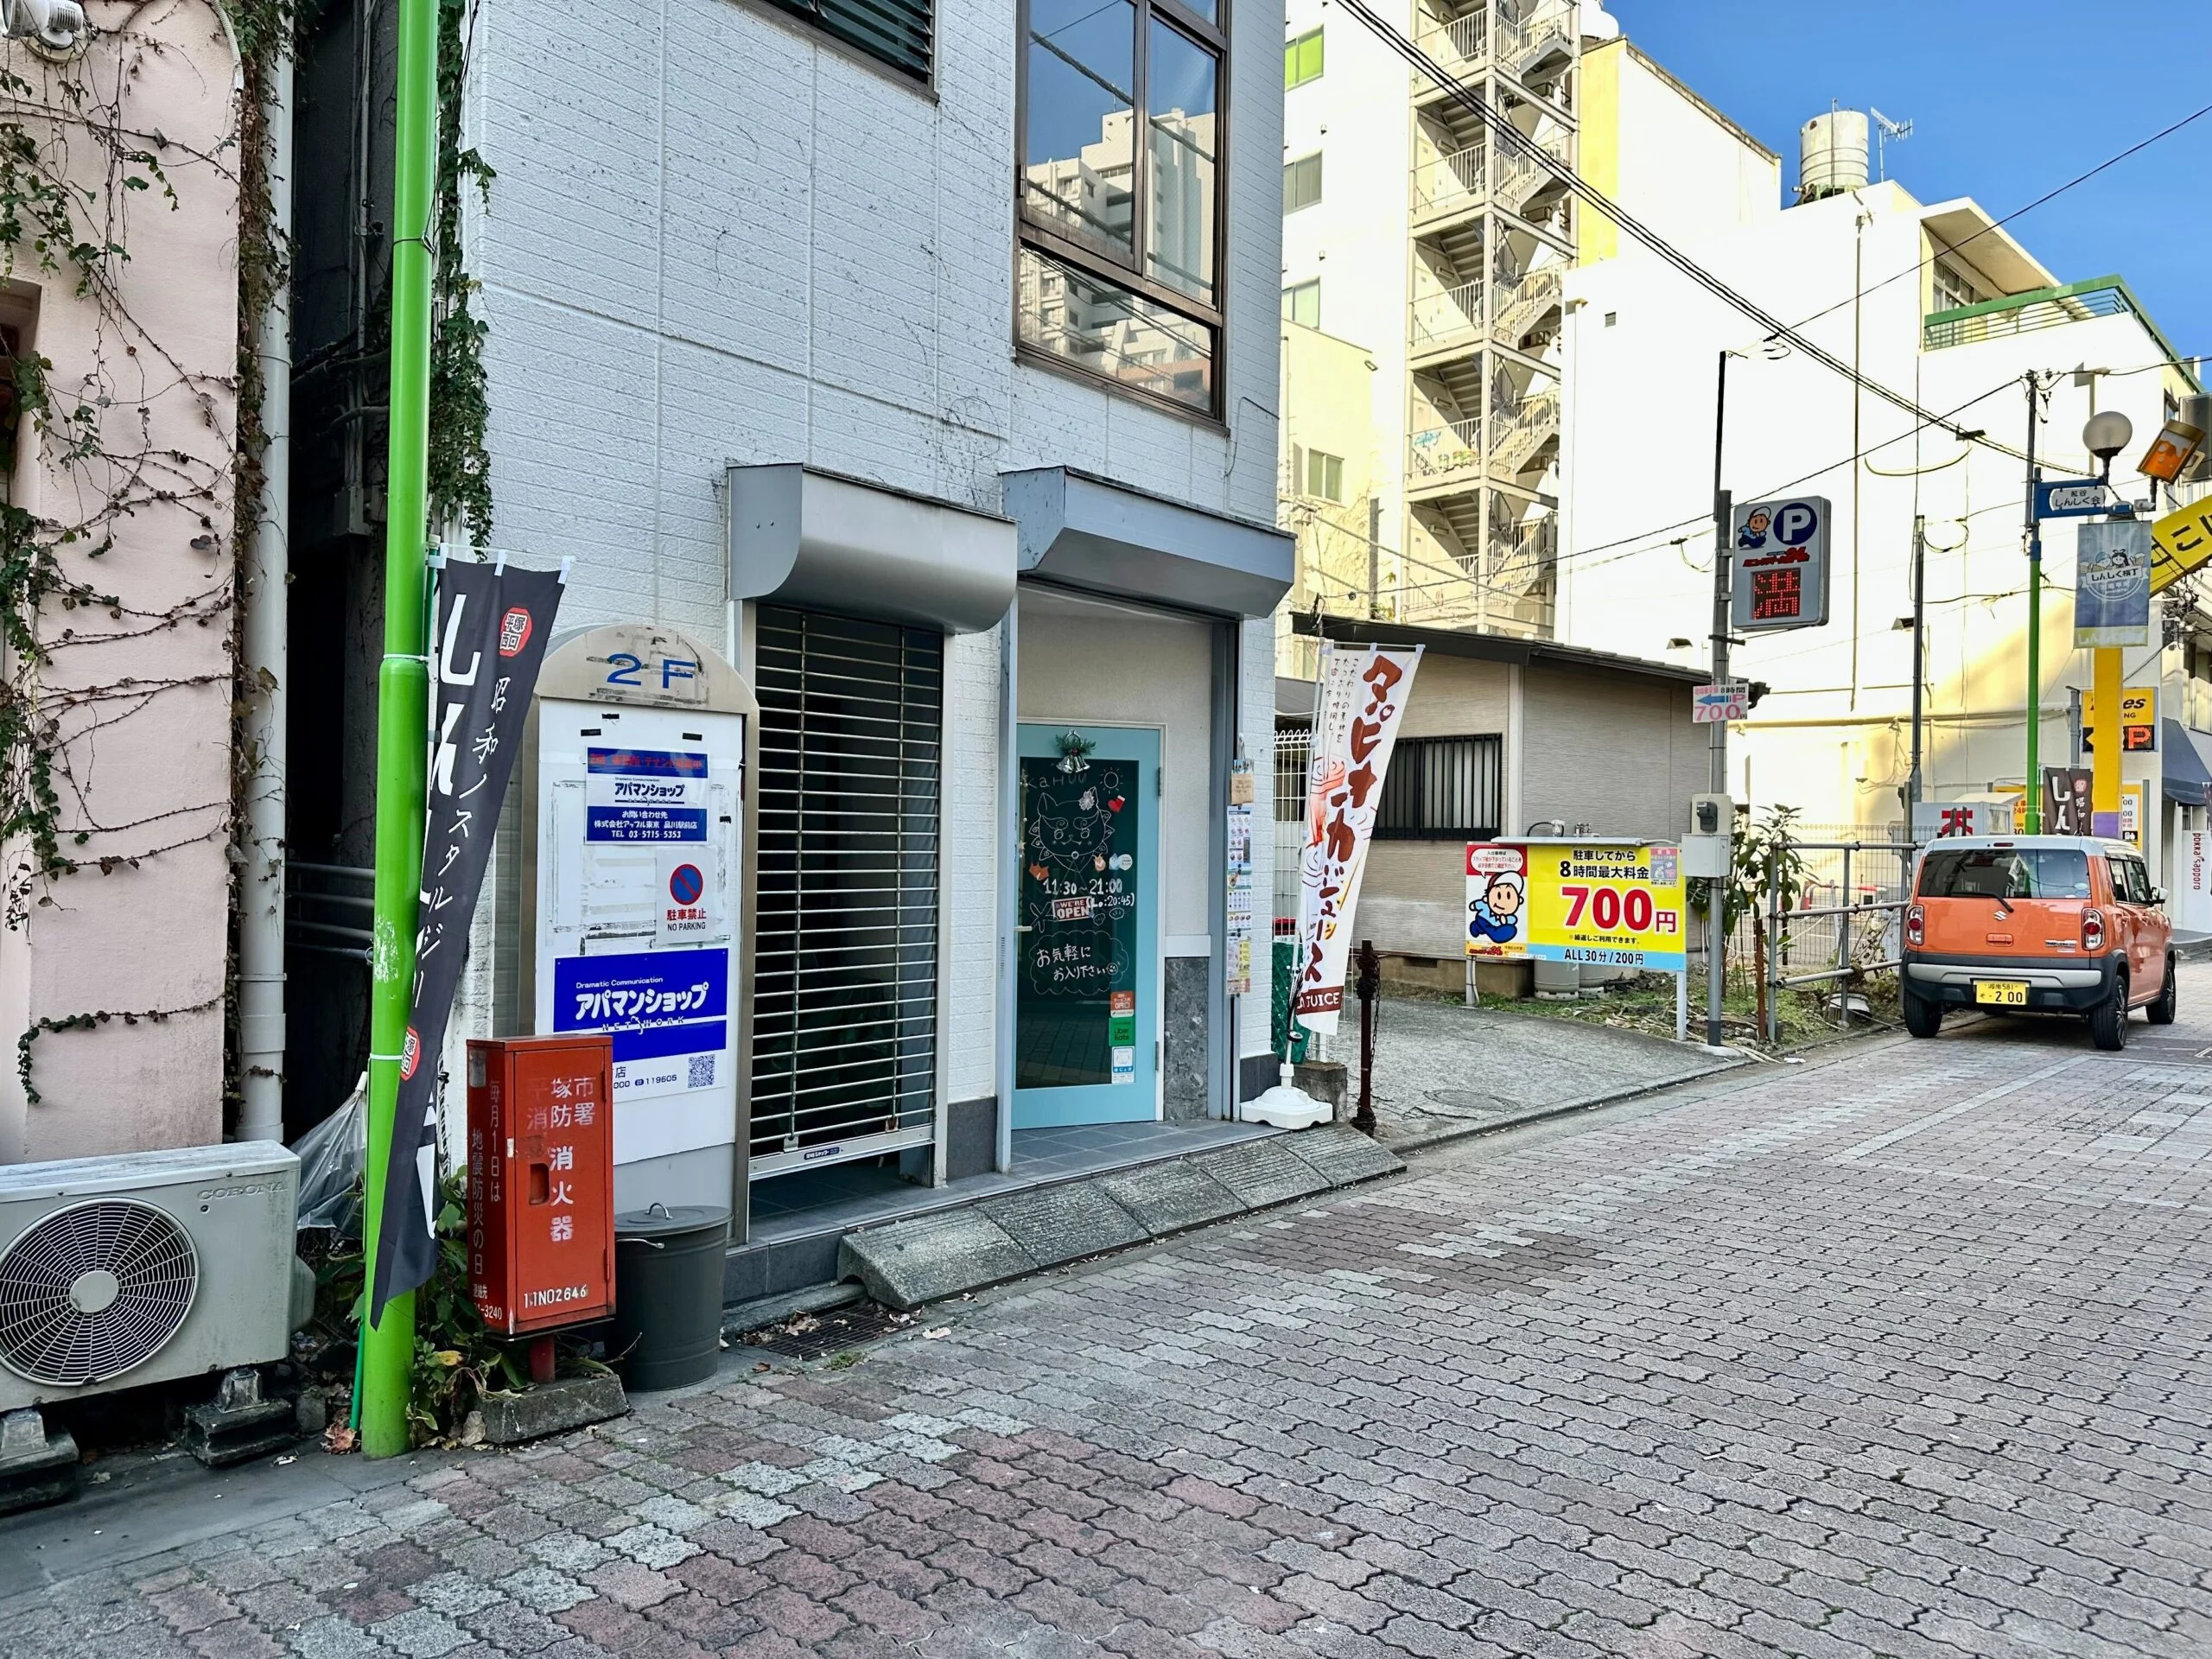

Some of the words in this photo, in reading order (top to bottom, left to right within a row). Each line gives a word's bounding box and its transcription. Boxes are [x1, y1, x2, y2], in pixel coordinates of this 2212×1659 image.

[2056, 496, 2101, 507] しんしく会
[1783, 508, 1811, 542] P
[1753, 571, 1801, 620] 満
[505, 613, 527, 632] 平塚
[500, 632, 520, 650] 西口
[607, 653, 696, 689] 2F
[2128, 727, 2151, 750] P
[614, 782, 685, 797] アパマンショップ
[622, 810, 668, 819] お問い合わせ先
[415, 677, 511, 1008] 昭和ノスタルジー
[1573, 850, 1636, 861] 駐車してから
[1560, 861, 1649, 880] 8時間最大料金
[1057, 906, 1089, 918] OPEN
[1059, 899, 1084, 908] WE'RE
[1561, 887, 1676, 933] 700円
[667, 908, 707, 921] 駐車禁止
[678, 922, 705, 931] PARKING
[1037, 944, 1091, 968] お気軽に
[575, 980, 609, 989] Dramatic
[611, 976, 664, 986] Communication
[1053, 967, 1106, 982] お入り下さい
[575, 982, 709, 1020] アパマンショップ
[526, 1103, 596, 1128] 消防署
[549, 1146, 574, 1242] 消火器
